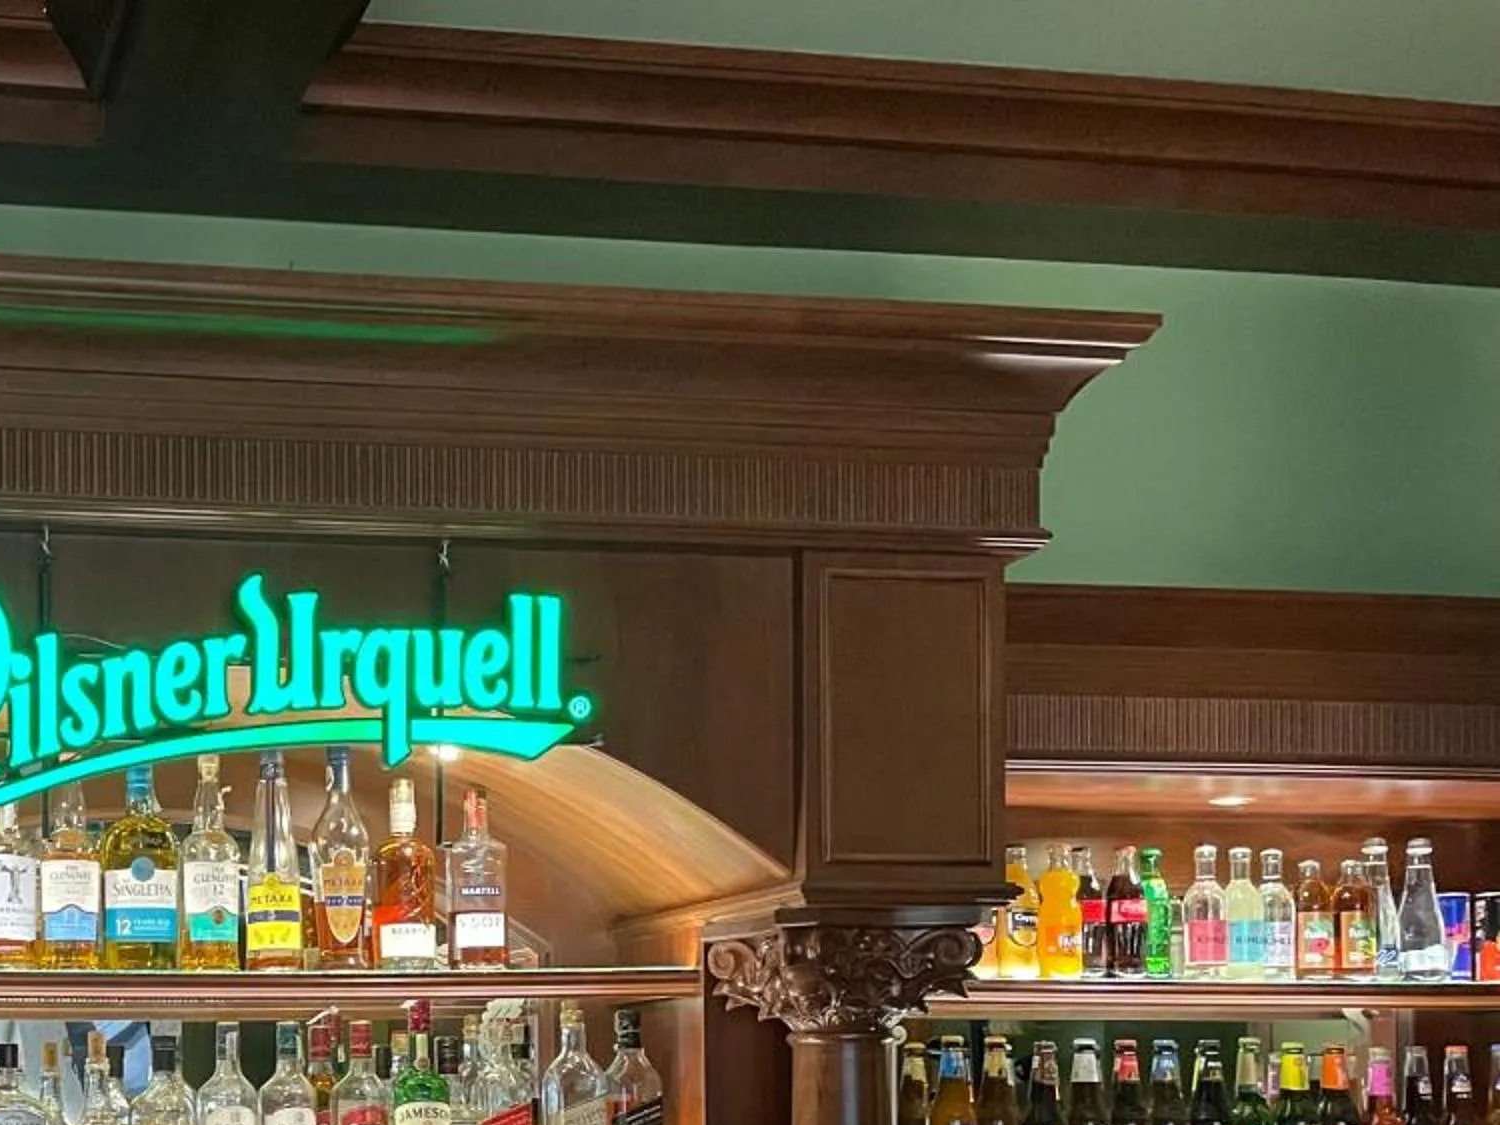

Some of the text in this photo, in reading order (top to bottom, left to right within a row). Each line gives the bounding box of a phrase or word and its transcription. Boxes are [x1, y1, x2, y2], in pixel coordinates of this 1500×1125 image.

[238, 572, 563, 769] Urquell
[461, 887, 501, 896] MARTELL
[116, 918, 132, 937] 12
[401, 1104, 449, 1121] JAMESO
